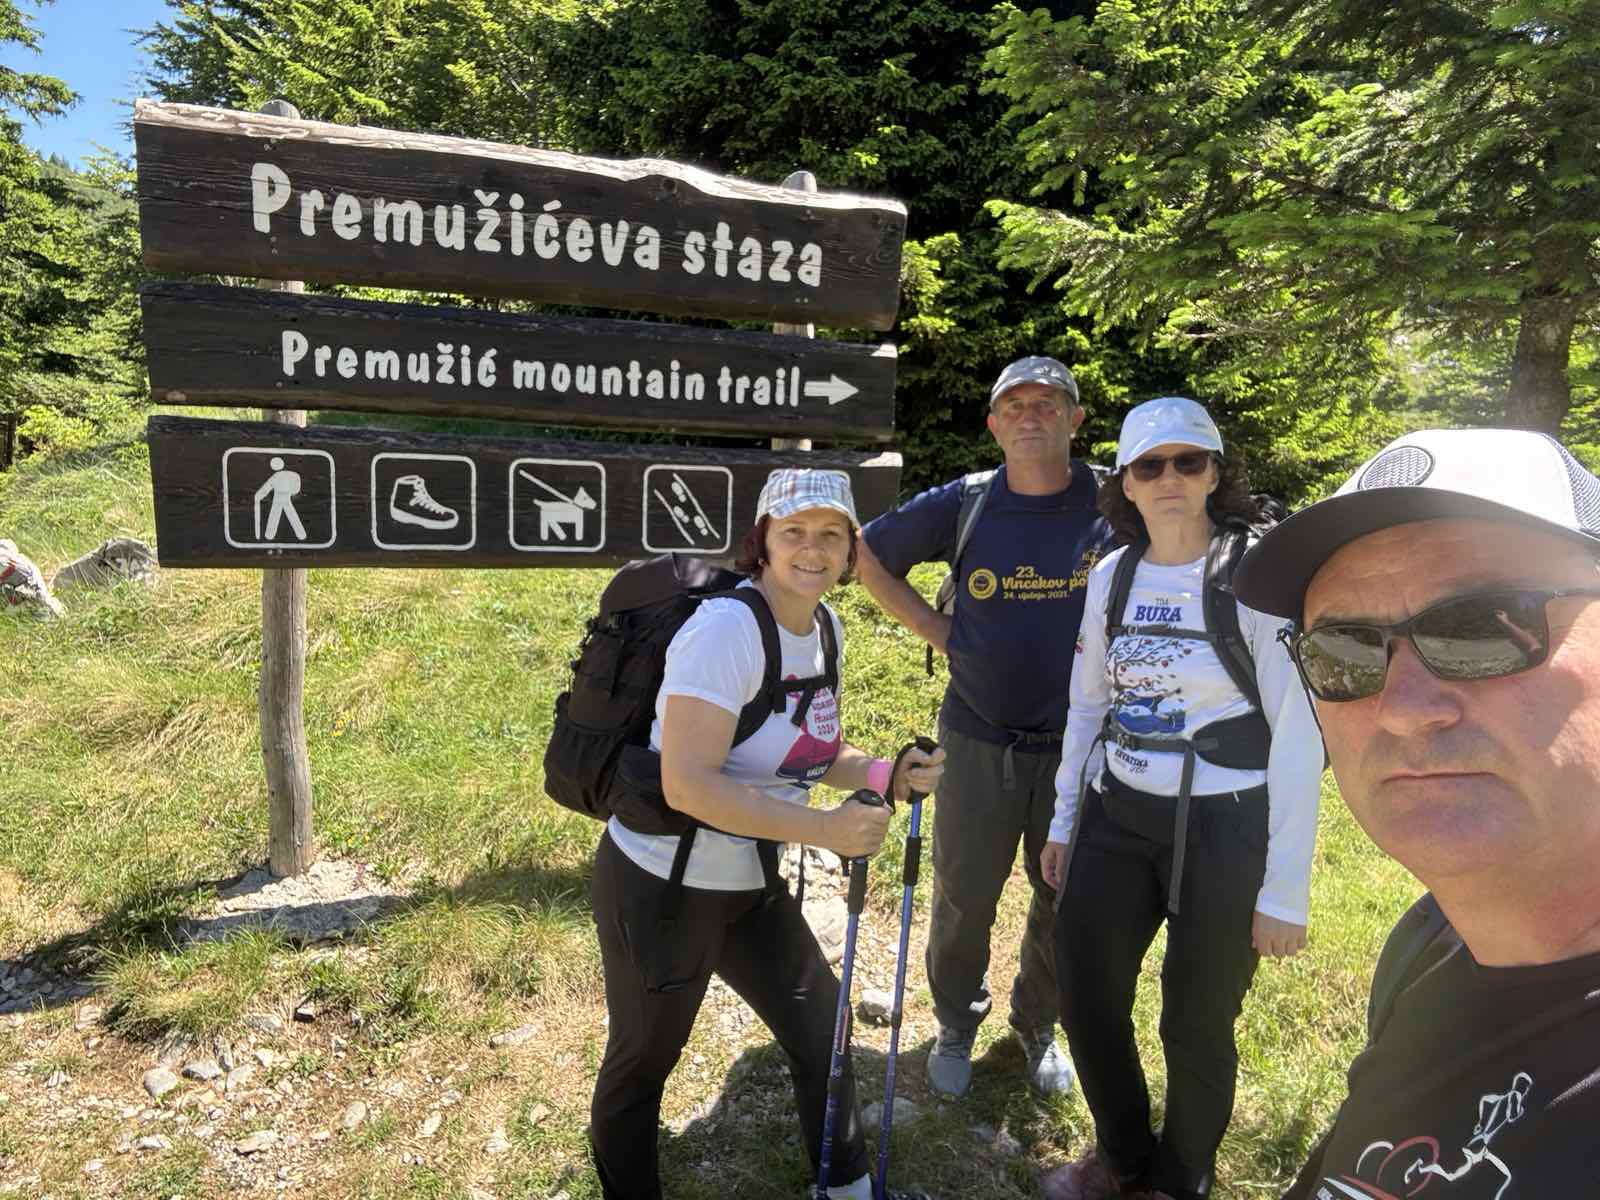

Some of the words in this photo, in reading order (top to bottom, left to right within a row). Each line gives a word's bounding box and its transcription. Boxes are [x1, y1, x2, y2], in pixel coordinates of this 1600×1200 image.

[251, 162, 661, 272] Premužićeva
[682, 222, 822, 287] staza
[282, 330, 498, 389] Premužić
[512, 359, 706, 404] mountain
[718, 366, 800, 407] trail
[1016, 566, 1039, 578] 23.
[1002, 575, 1066, 590] Vincekov
[1069, 577, 1088, 591] po
[1134, 605, 1182, 622] BURA
